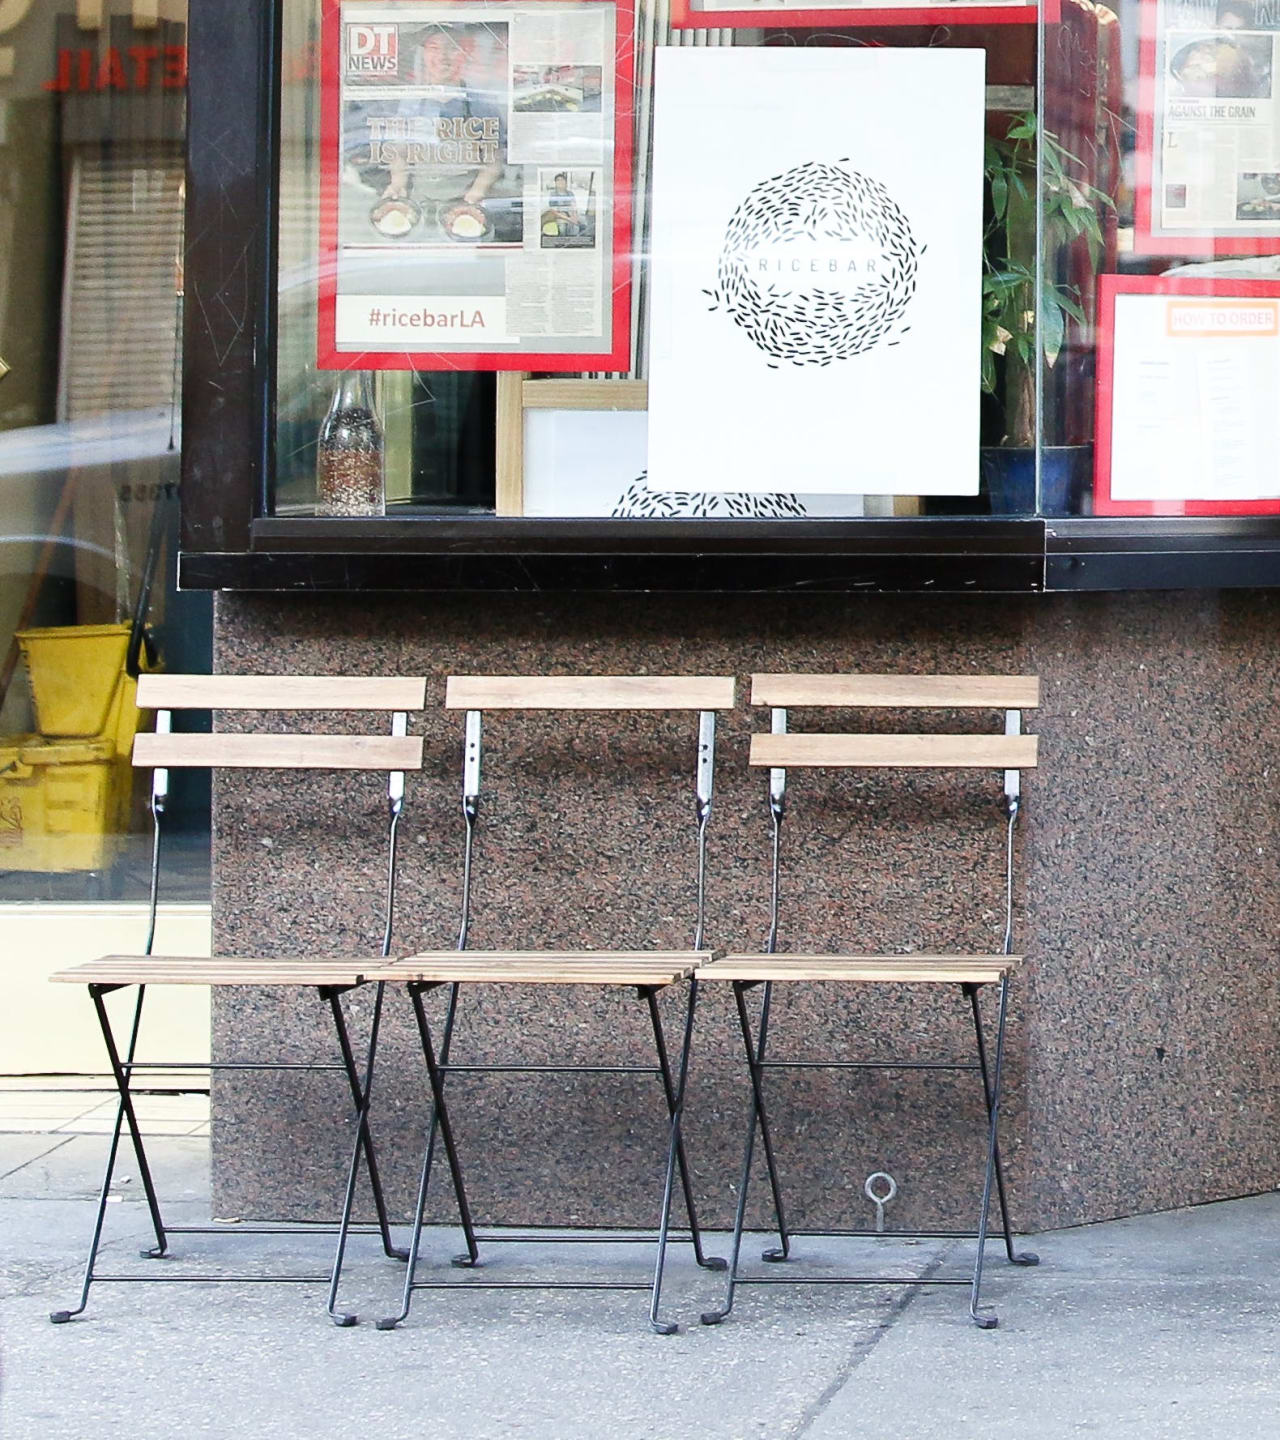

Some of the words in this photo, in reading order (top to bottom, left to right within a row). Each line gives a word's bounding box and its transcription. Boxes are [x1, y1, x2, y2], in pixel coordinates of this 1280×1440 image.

[350, 27, 396, 55] DT
[349, 56, 397, 71] NEWS
[1168, 105, 1208, 119] AGAINST
[1210, 105, 1226, 118] THE
[1228, 105, 1256, 119] GRAIN
[434, 116, 500, 140] RICE
[370, 141, 399, 164] IS
[407, 140, 500, 164] RIGHT
[369, 308, 486, 329] #ricebarLA
[1210, 312, 1228, 326] TO
[1230, 311, 1274, 326] ORDER
